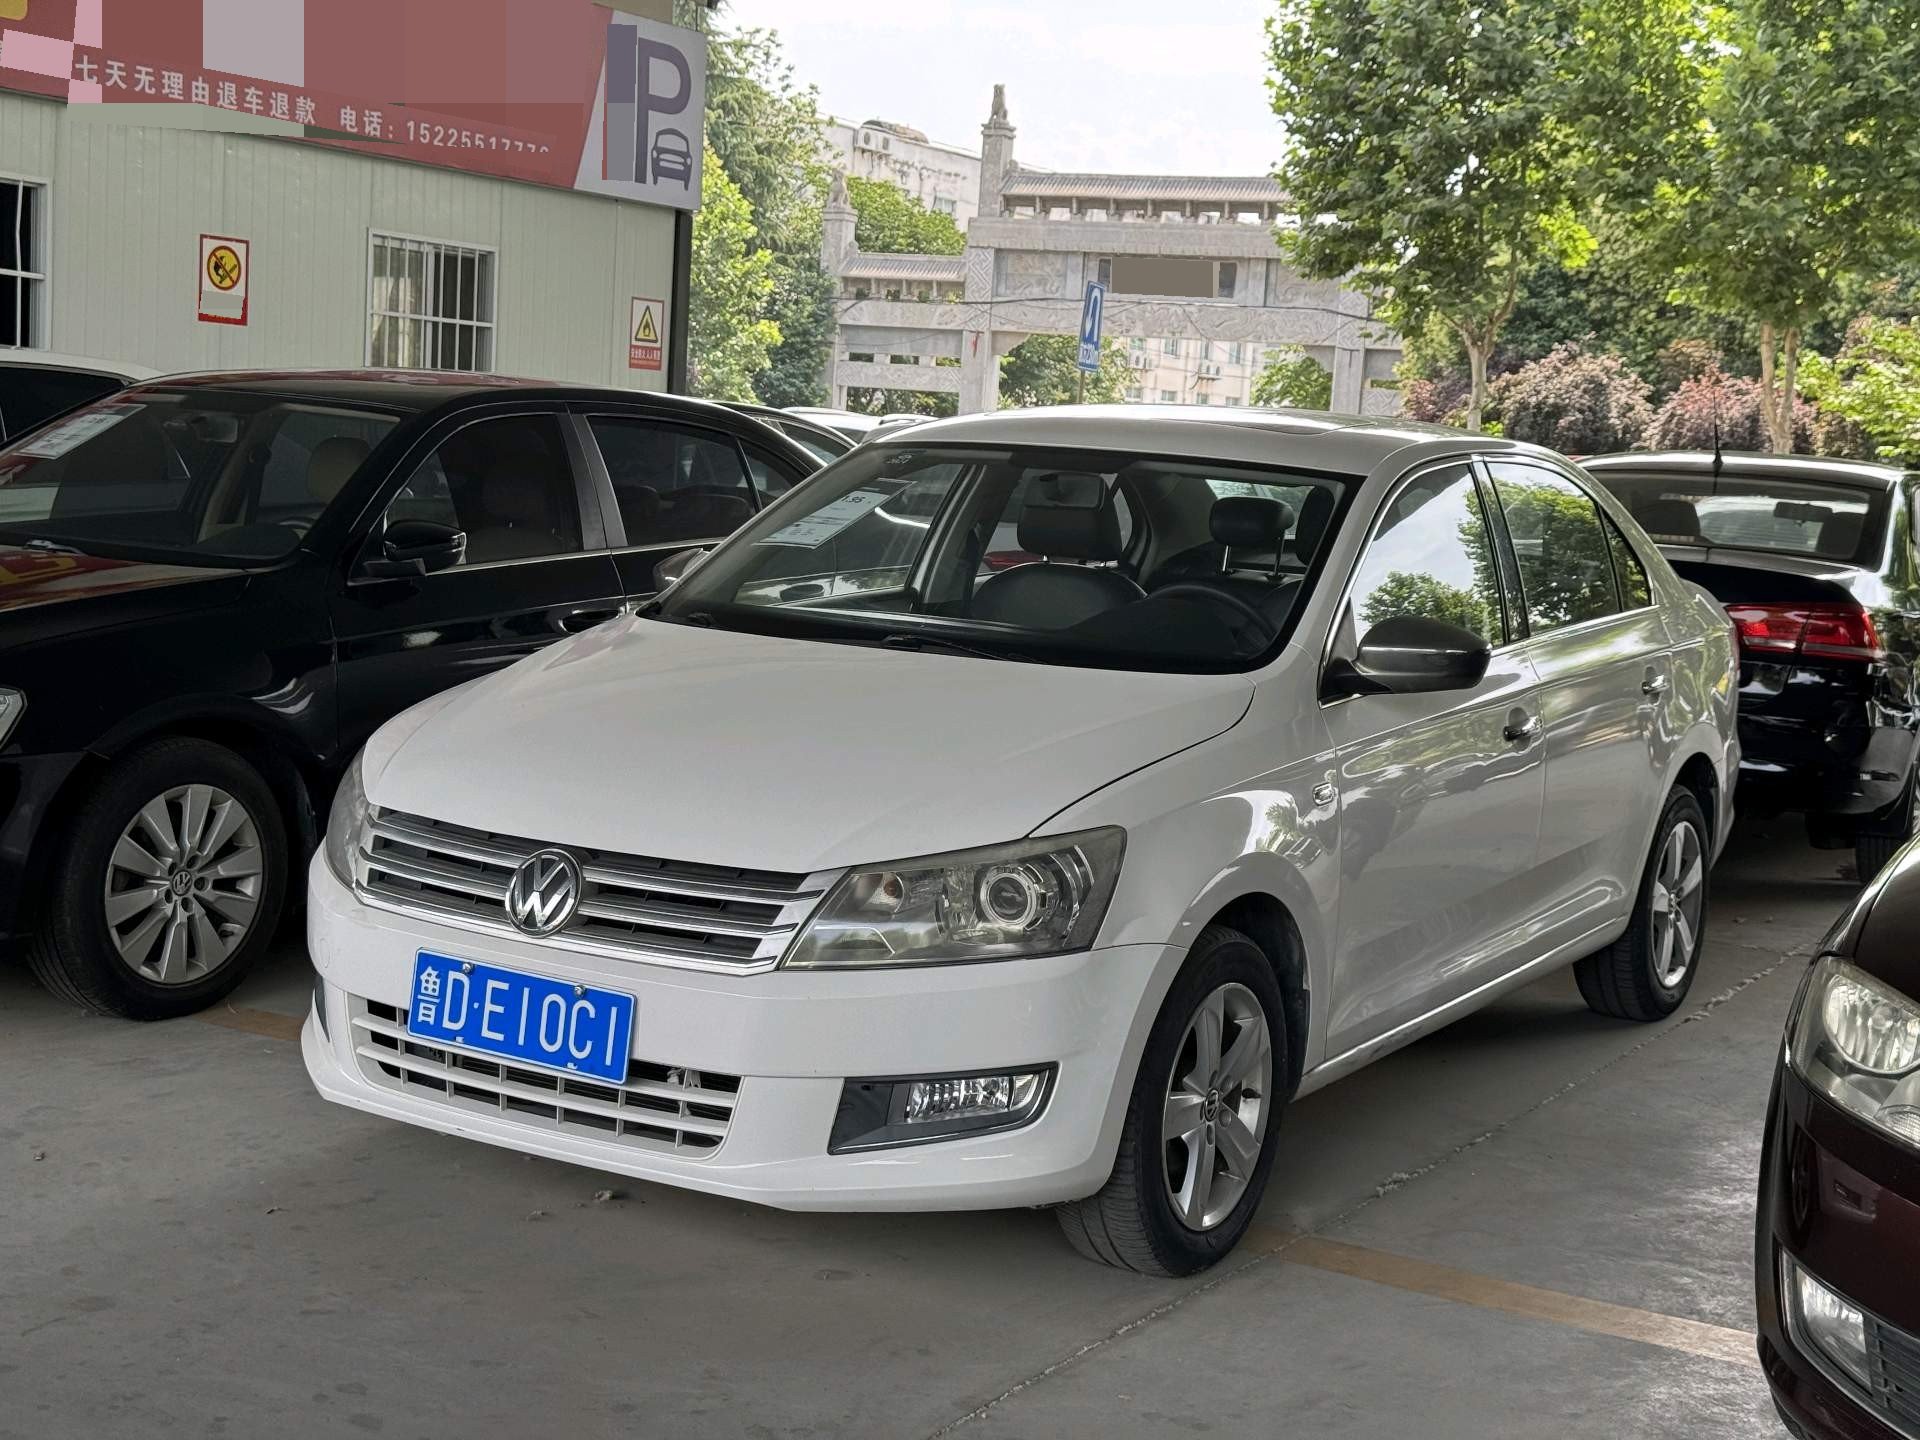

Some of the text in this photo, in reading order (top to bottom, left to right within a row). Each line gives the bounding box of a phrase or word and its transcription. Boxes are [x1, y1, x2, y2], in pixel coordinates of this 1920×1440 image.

[74, 55, 317, 125] 七天无理由退车退款
[634, 37, 692, 184] P
